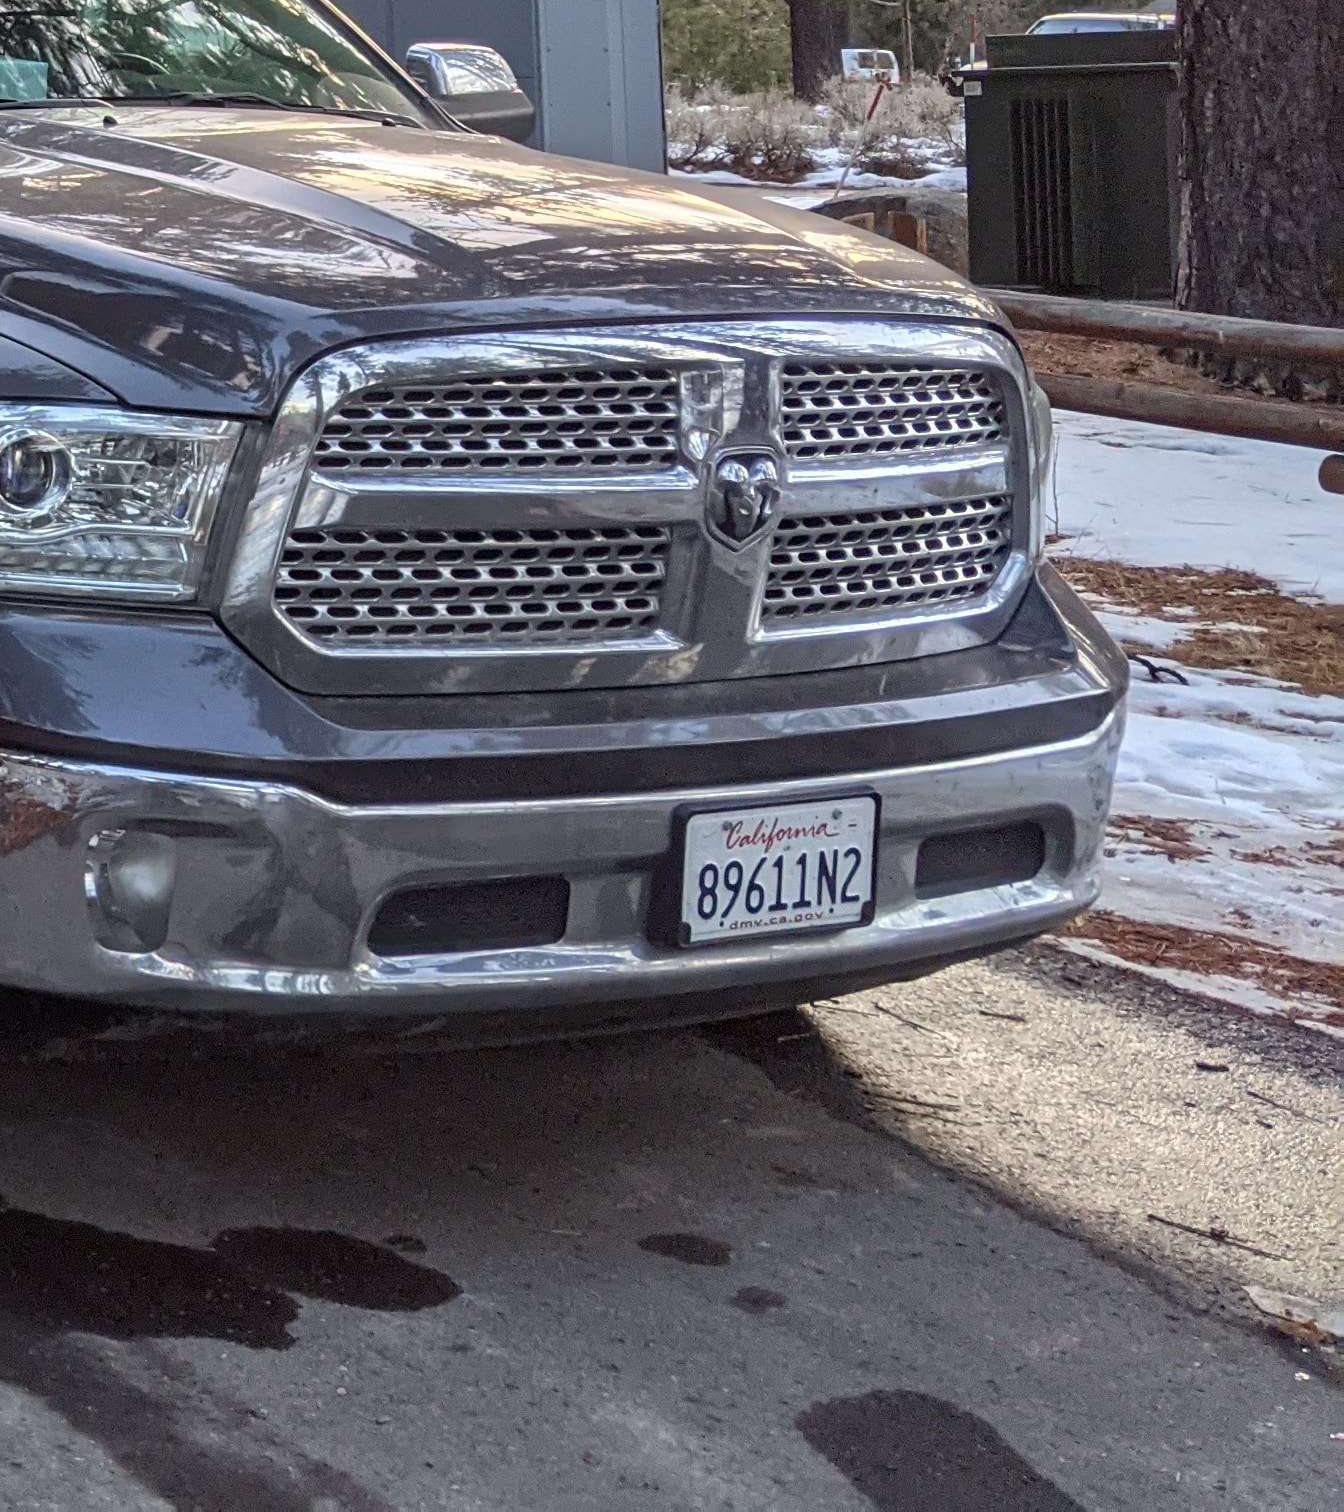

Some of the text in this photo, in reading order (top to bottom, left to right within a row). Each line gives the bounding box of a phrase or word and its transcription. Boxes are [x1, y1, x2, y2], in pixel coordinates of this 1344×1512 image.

[725, 817, 841, 854] California
[697, 847, 861, 921] 89611N2
[729, 911, 824, 930] dmv.ca.gov
